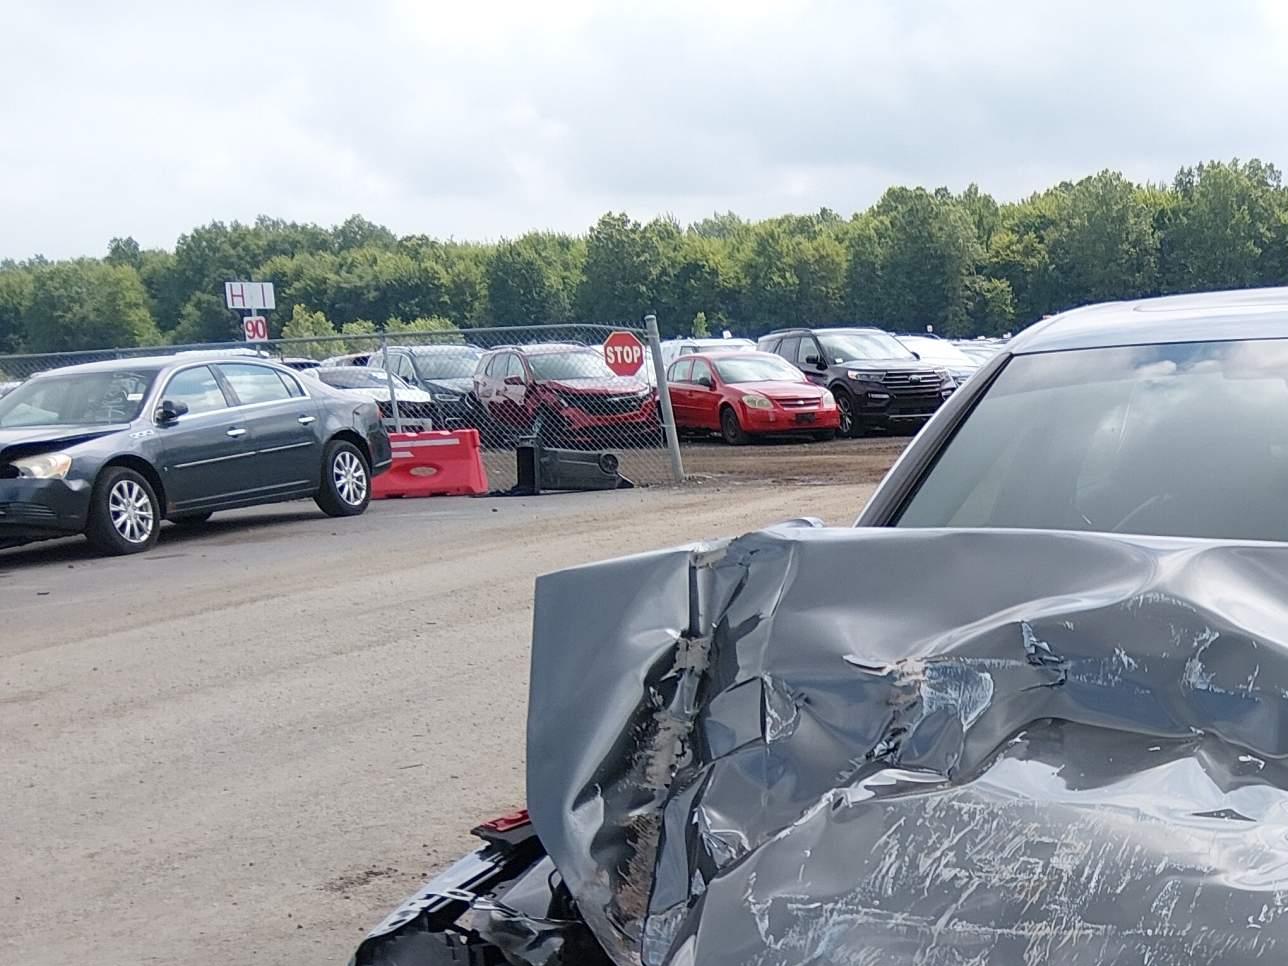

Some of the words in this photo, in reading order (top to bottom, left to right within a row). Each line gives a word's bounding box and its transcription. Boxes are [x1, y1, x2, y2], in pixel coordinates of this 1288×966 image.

[230, 284, 245, 307] H
[245, 319, 266, 339] 90
[606, 345, 641, 364] STOP
